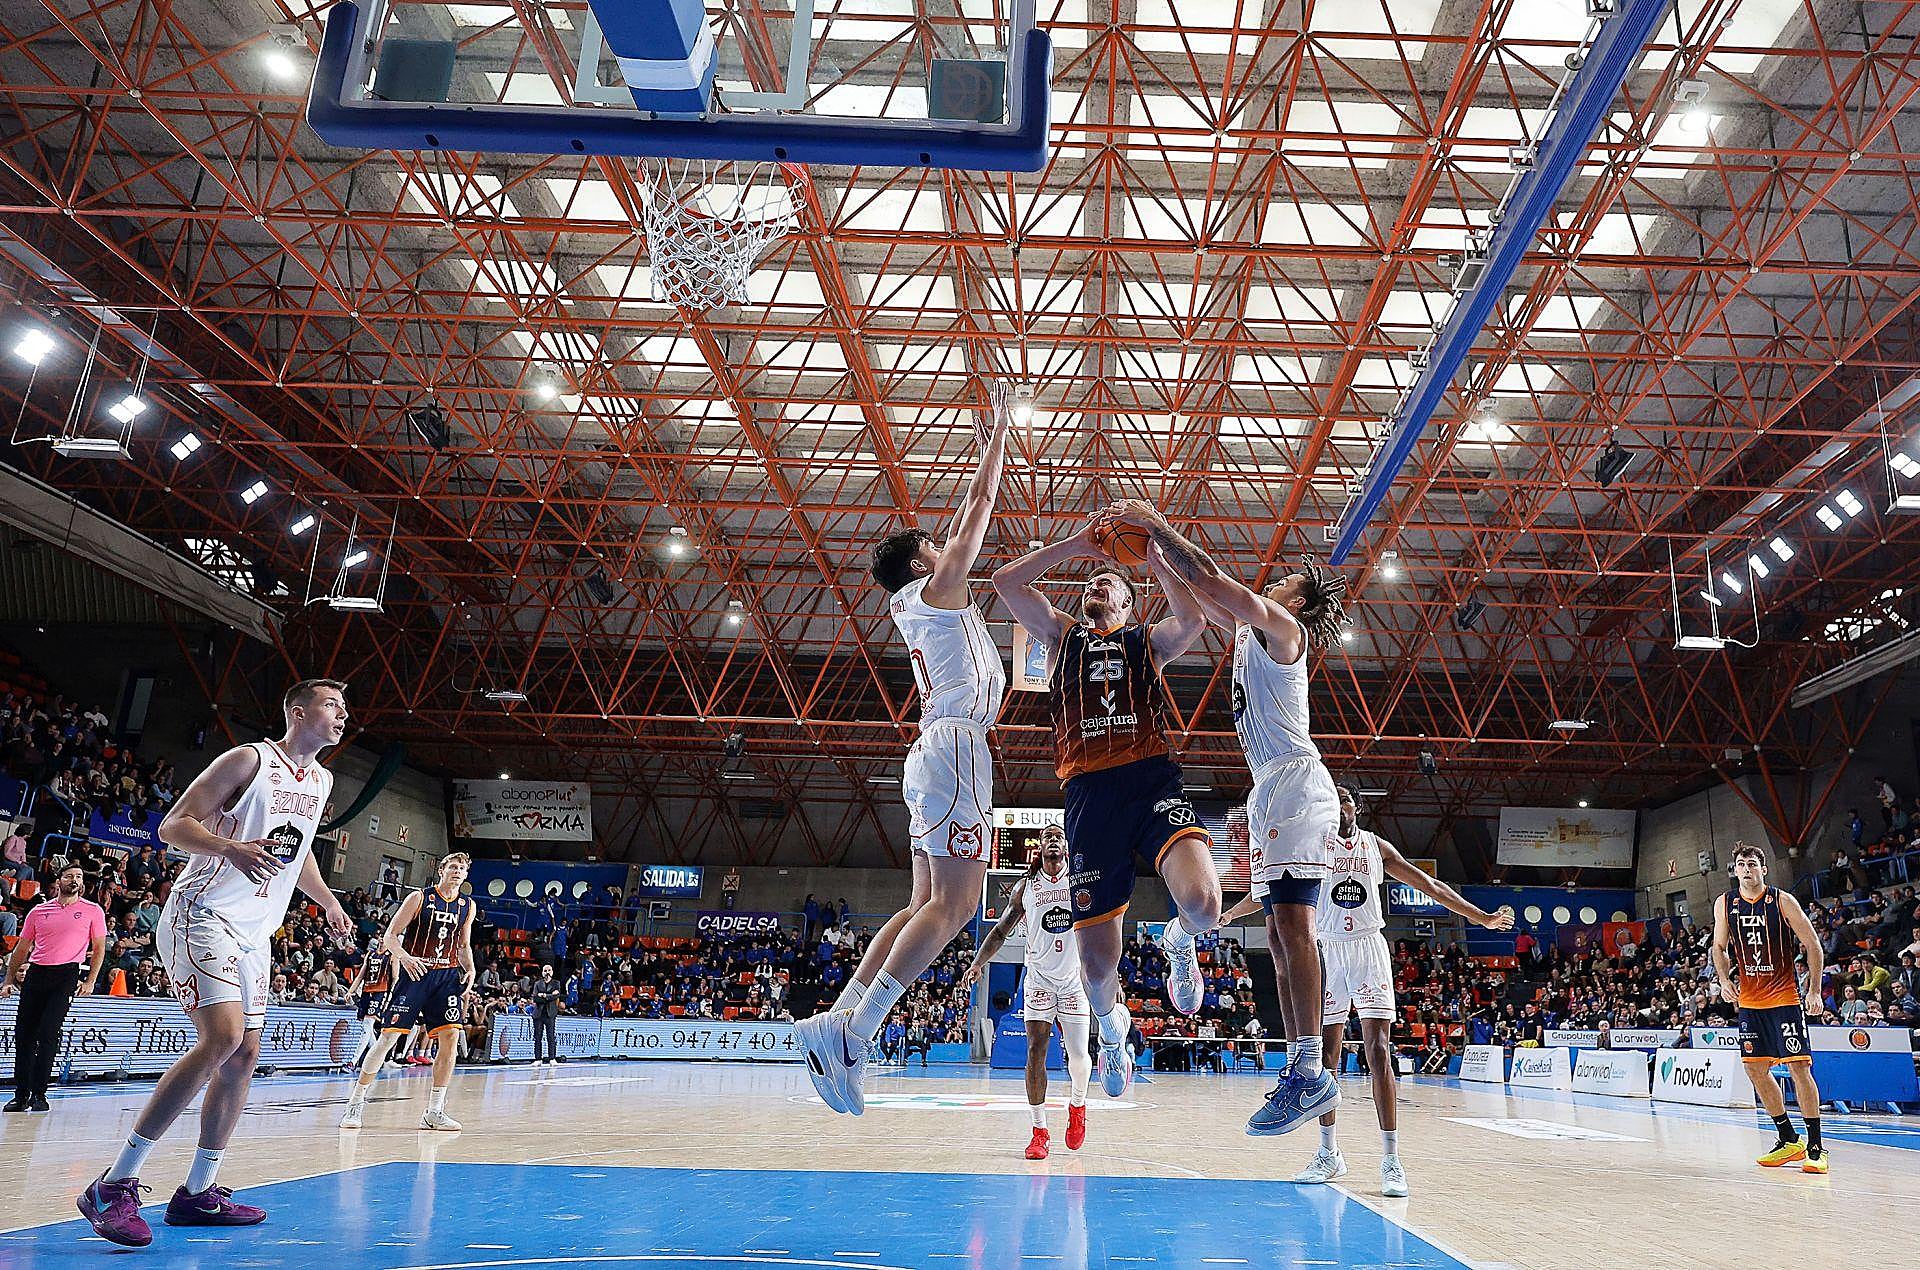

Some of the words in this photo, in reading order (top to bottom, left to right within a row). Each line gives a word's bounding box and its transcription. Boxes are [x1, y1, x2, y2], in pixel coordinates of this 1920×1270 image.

[1089, 658, 1124, 682] 25
[1080, 713, 1138, 730] cajarural
[642, 869, 685, 888] SALIDA
[1391, 888, 1434, 906] SALIDA
[697, 915, 779, 931] CADIELSA
[1045, 912, 1071, 921] Estrella
[1740, 914, 1766, 927] TZN
[1343, 916, 1354, 932] 3
[437, 926, 448, 940] 8
[1747, 931, 1763, 945] 21
[1054, 939, 1063, 953] 9
[369, 965, 379, 973] 35
[369, 1000, 380, 1008] 35
[447, 995, 458, 1008] 8
[1781, 1022, 1799, 1037] 21
[611, 1028, 665, 1049] Tfno.
[672, 1030, 713, 1050] 947
[717, 1031, 742, 1051] 47
[748, 1031, 777, 1051] 40
[782, 1031, 801, 1051] 4
[1705, 1075, 1723, 1089] salud
